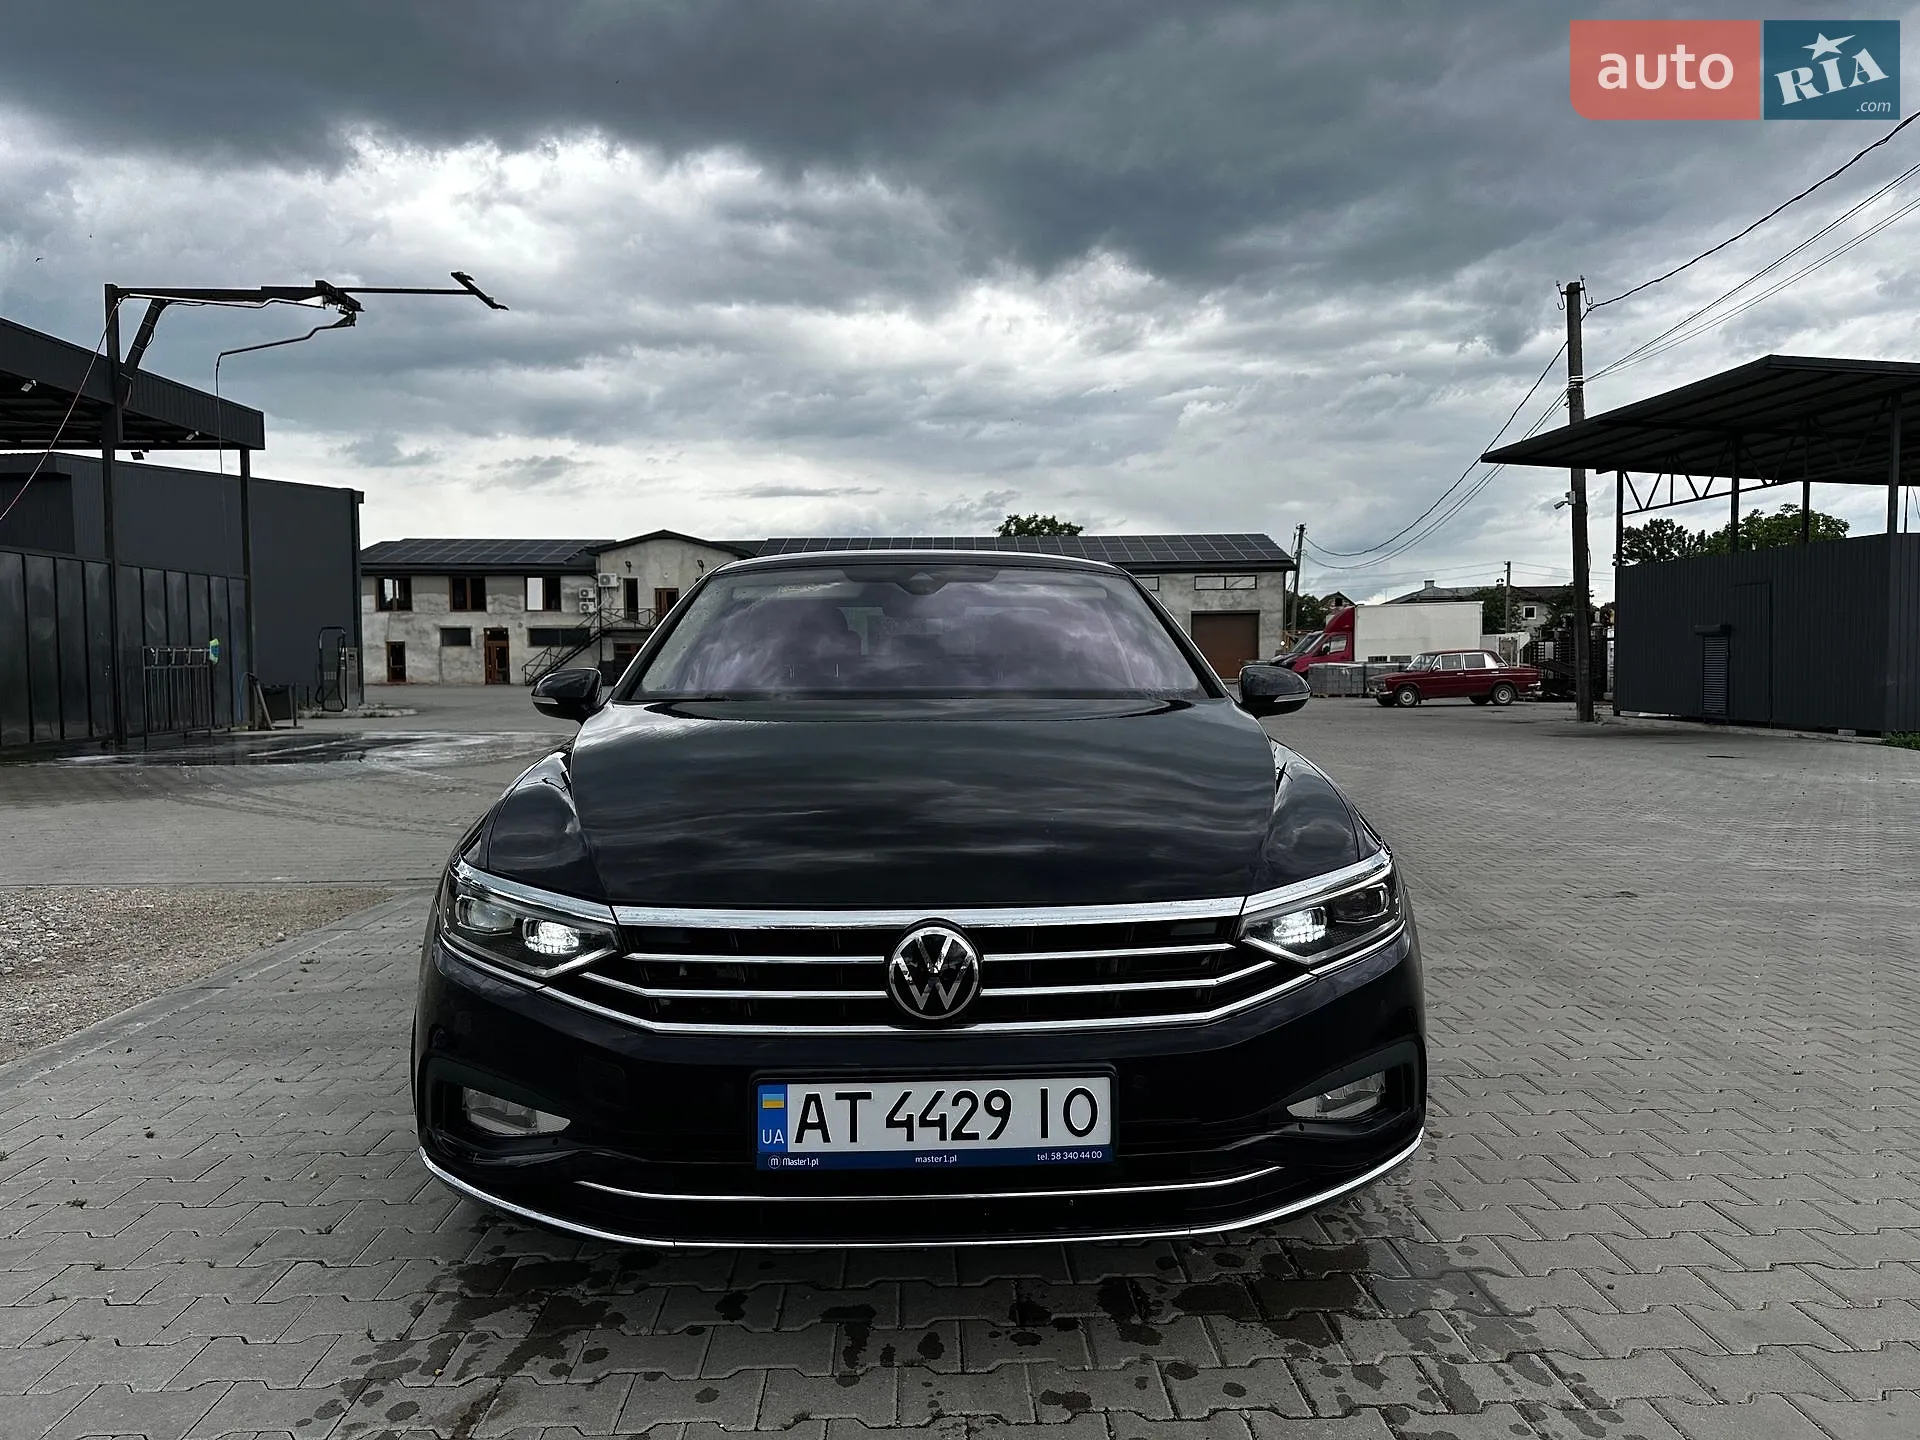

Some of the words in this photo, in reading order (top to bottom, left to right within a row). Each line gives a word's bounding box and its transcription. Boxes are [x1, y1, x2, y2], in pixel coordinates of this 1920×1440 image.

[794, 1091, 873, 1144] AT
[885, 1089, 1012, 1142] 4429
[1040, 1086, 1099, 1139] IO
[762, 1129, 785, 1144] UA
[1037, 1152, 1050, 1161] tel.
[1051, 1152, 1062, 1161] 58
[1063, 1151, 1079, 1160] 340
[1080, 1151, 1090, 1159] 44
